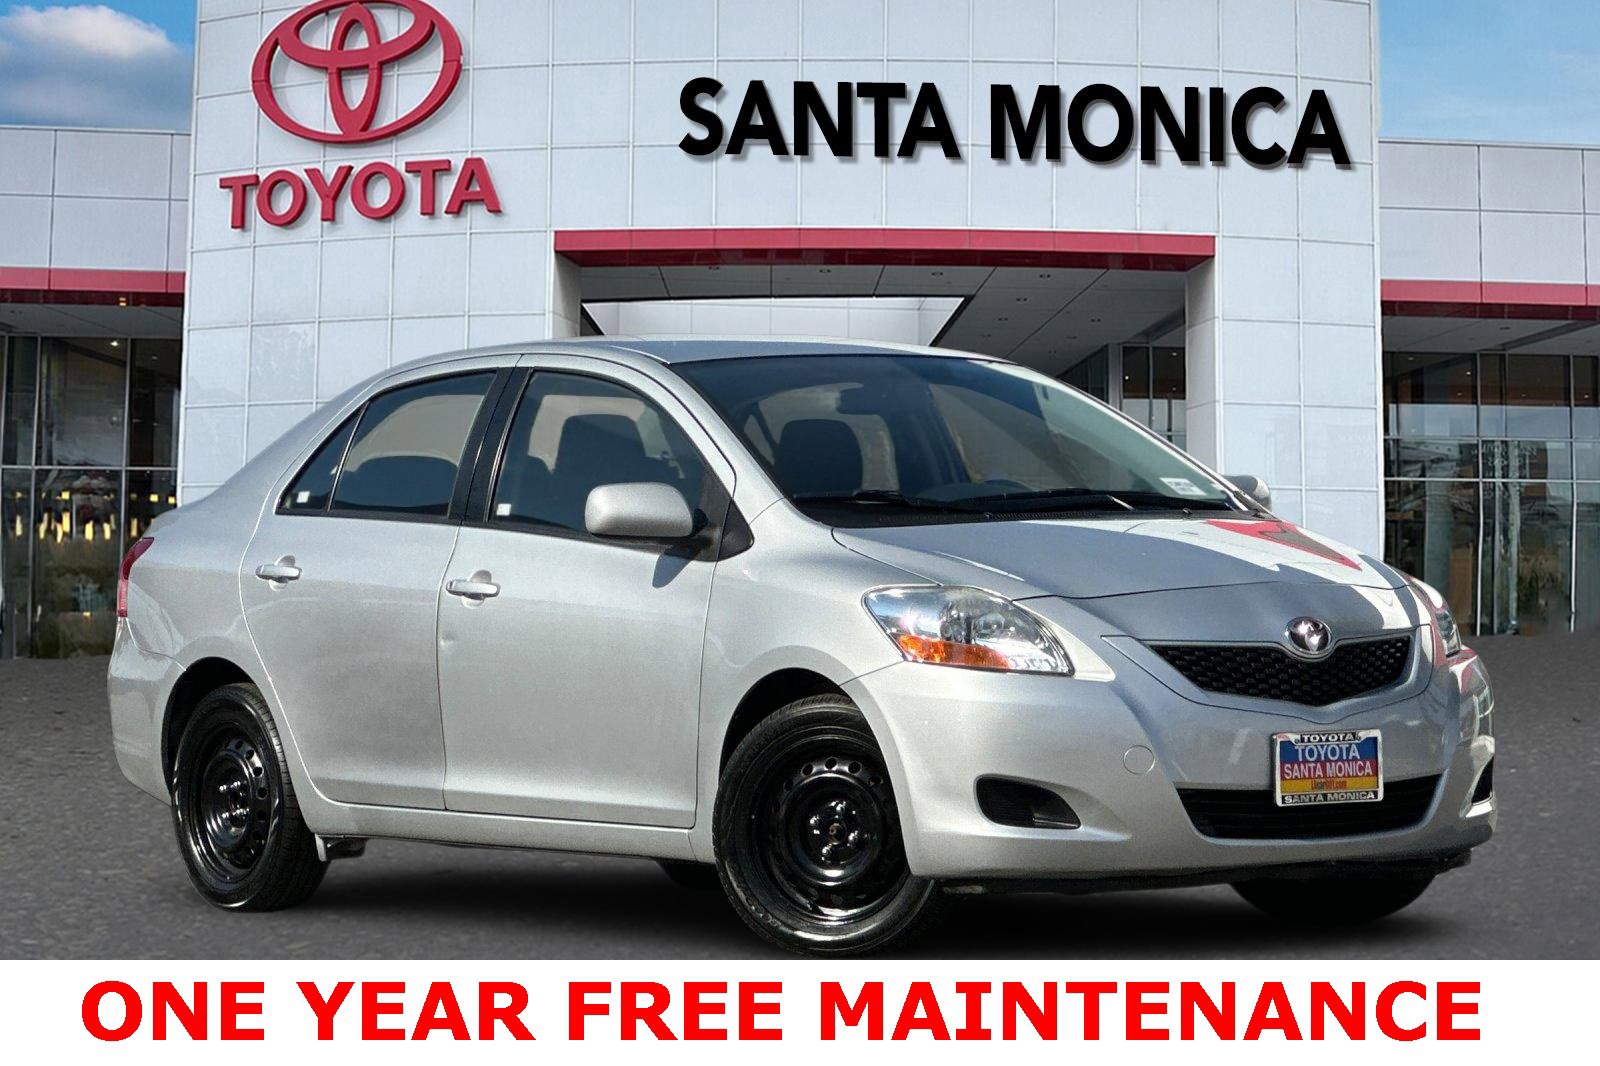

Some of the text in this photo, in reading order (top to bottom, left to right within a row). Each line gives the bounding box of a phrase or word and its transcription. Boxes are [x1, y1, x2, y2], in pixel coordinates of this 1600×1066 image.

[679, 78, 1351, 168] SANTA MONICA
[220, 157, 502, 229] TOYOTA
[1302, 733, 1354, 743] TOYOTA
[1295, 744, 1360, 761] TOYOTA
[1284, 760, 1373, 779] SANTA MONICA
[1284, 791, 1375, 804] SANTA MONICA
